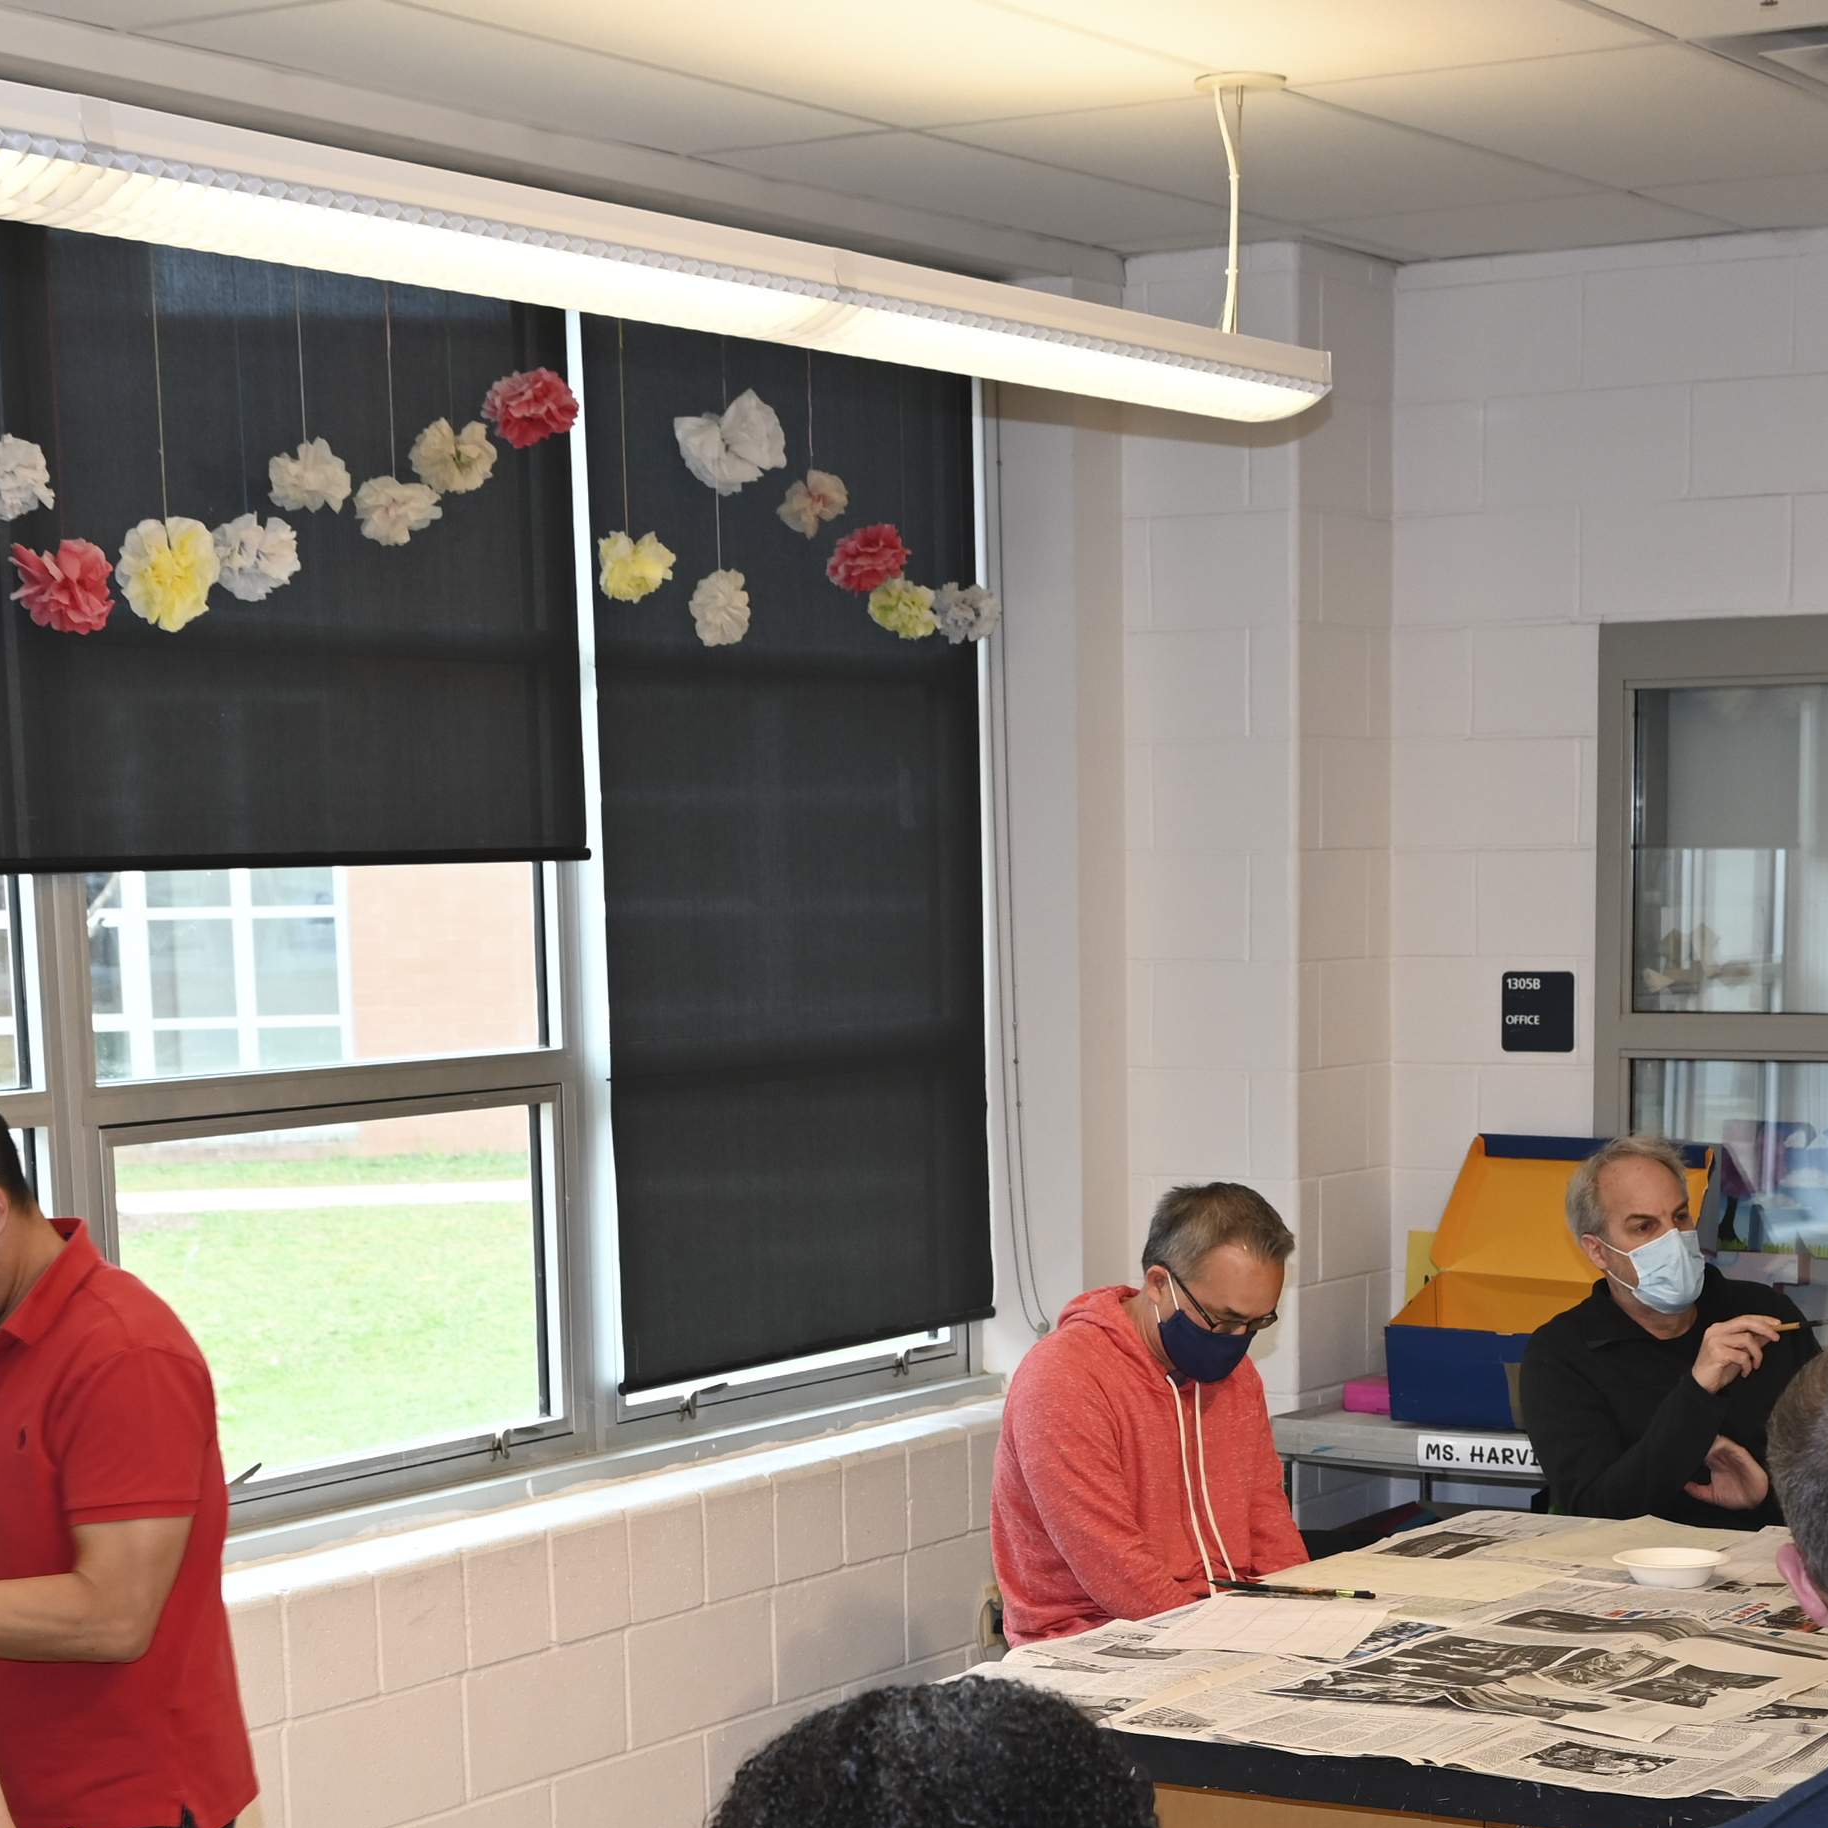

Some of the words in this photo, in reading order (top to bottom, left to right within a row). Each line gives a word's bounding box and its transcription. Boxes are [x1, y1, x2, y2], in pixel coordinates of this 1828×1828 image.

[1506, 977, 1541, 990] 1305B
[1505, 1014, 1540, 1025] OFFICE
[1425, 1443, 1460, 1462] MS.
[1470, 1445, 1539, 1467] HARVI
